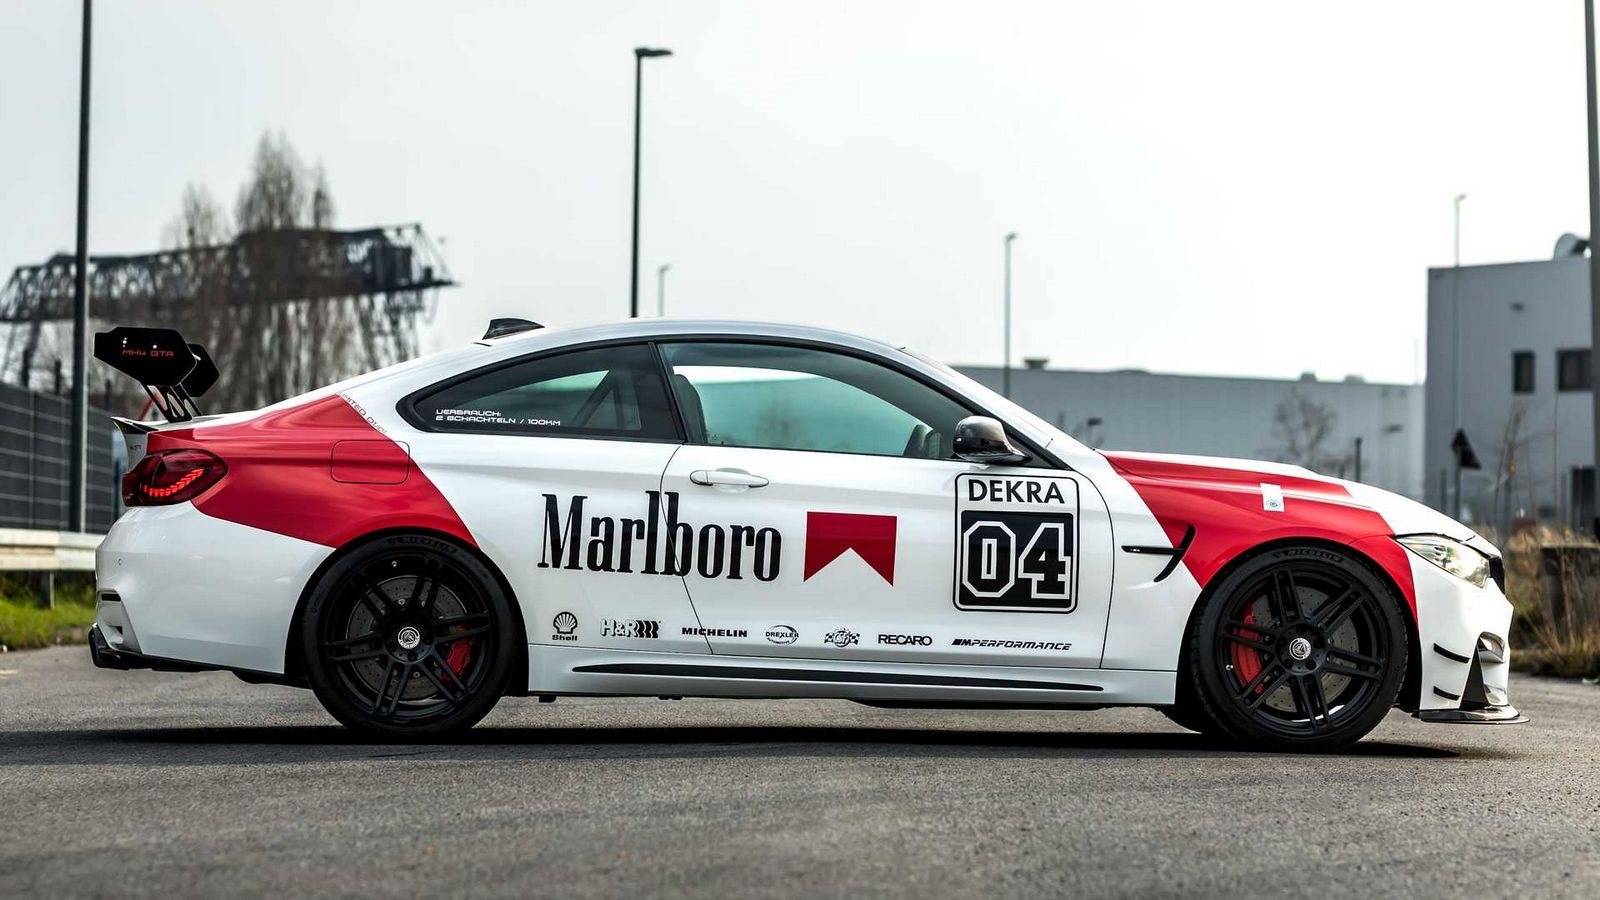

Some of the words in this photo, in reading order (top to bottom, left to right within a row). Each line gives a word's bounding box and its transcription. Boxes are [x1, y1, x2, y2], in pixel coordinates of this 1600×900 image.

[150, 350, 174, 358] GTA
[446, 416, 516, 424] SCHACHTELN
[527, 418, 561, 426] 100KM
[968, 479, 1065, 504] DEKRA
[537, 490, 782, 582] Marlboro
[962, 521, 1071, 600] 04
[600, 619, 638, 638] H&R
[681, 627, 748, 637] MICHELIN
[765, 631, 799, 639] DREXLER
[877, 634, 933, 646] RECARO
